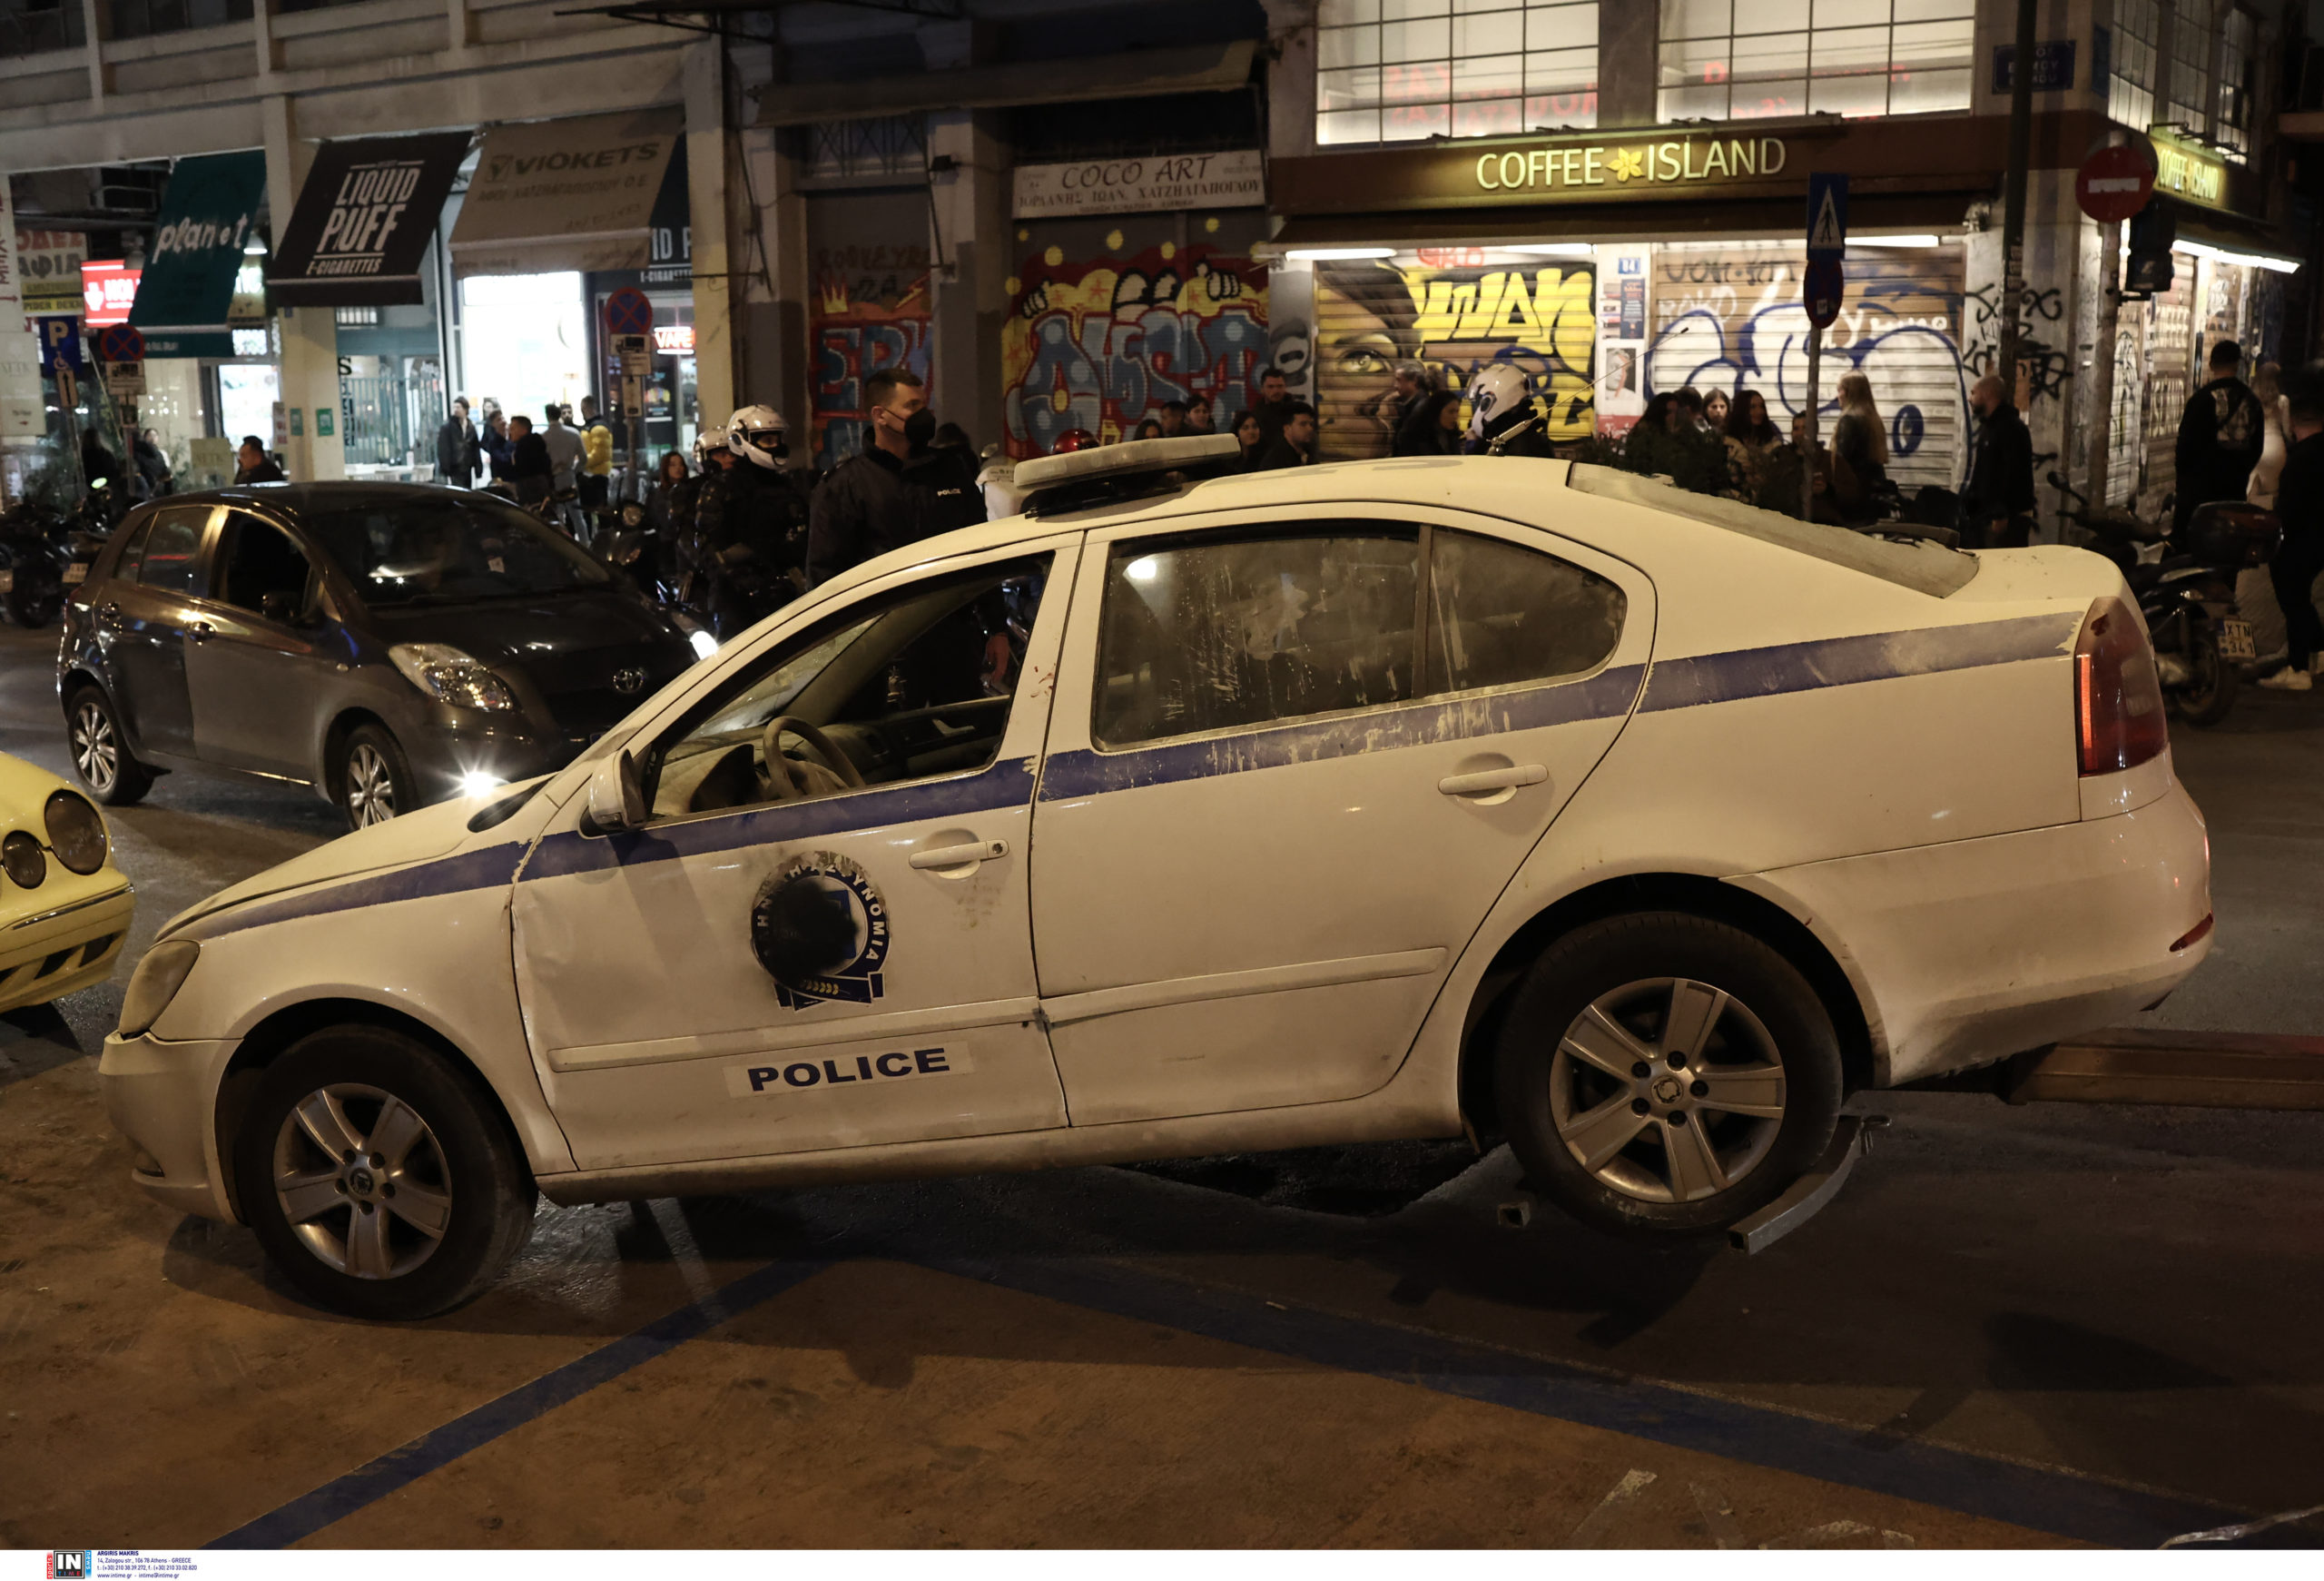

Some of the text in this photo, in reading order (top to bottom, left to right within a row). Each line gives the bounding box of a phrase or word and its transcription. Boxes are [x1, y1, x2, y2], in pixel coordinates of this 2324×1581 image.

[515, 143, 661, 174] VIOKETS
[1062, 162, 1142, 189] COCO
[1155, 154, 1216, 182] ART
[1476, 138, 1787, 190] COFFEE ISLAND
[2159, 148, 2219, 200] COFFEE ISLAND
[335, 167, 421, 205] LIQUID
[152, 212, 248, 264] planet
[316, 203, 408, 253] PUFF
[306, 258, 383, 276] E-CIGARETTES
[48, 321, 69, 348] P
[655, 331, 694, 349] VAPE
[747, 1047, 950, 1092] POLICE
